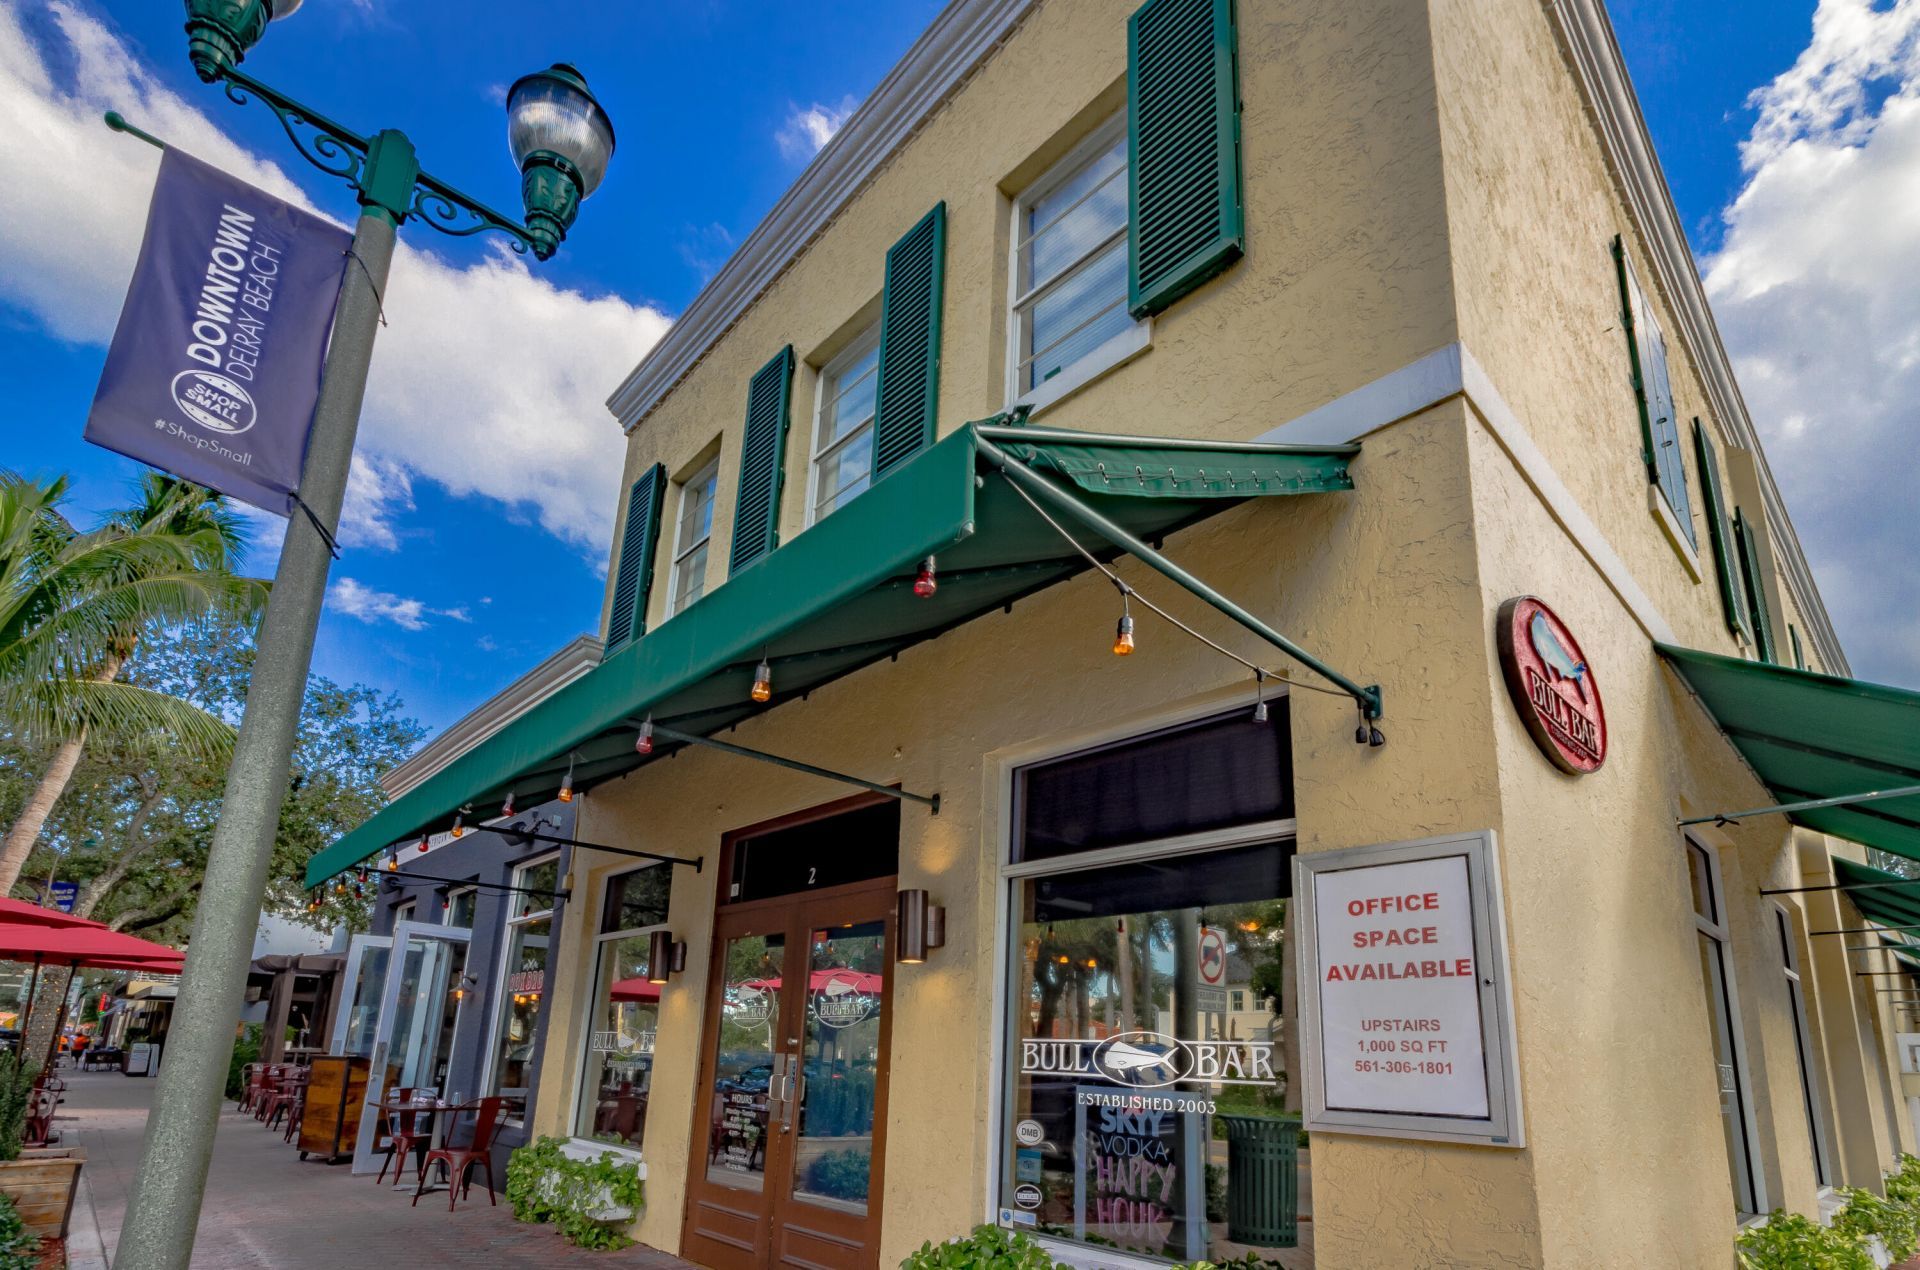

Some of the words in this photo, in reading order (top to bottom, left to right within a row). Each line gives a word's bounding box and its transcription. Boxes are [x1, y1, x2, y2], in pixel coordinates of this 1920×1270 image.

[186, 204, 255, 368] DOWNTOWN
[242, 241, 282, 312] BEACH
[226, 307, 266, 381] DELRAY
[185, 388, 239, 424] SMALL
[193, 383, 242, 411] SHOP
[154, 418, 252, 466] #ShopSmall
[1531, 672, 1567, 727] BULL
[1571, 709, 1597, 752] BAR
[807, 867, 817, 885] 2
[1347, 893, 1440, 916] OFFICE
[1353, 926, 1438, 948] SPACE
[1326, 959, 1473, 982] AVAILABLE
[820, 1003, 842, 1016] BULL
[844, 1002, 864, 1015] BAR
[1361, 1019, 1441, 1032] UPSTAIRS
[592, 1033, 614, 1049] BULL
[642, 1034, 656, 1050] BA
[1357, 1040, 1396, 1054] 1,000
[1400, 1041, 1424, 1053] SQ
[1428, 1041, 1448, 1053] FT
[1021, 1042, 1090, 1072] BULL
[1195, 1045, 1277, 1080] BAR
[1354, 1060, 1453, 1075] 561-306-1801
[731, 1093, 753, 1104] HOURS
[1077, 1092, 1173, 1112] ESTABLISHED
[1177, 1098, 1217, 1115] 2003
[1021, 1127, 1039, 1138] DMB
[1100, 1105, 1166, 1137] SKYY
[1099, 1135, 1169, 1161] VODKA
[1096, 1155, 1177, 1201] HAPPY
